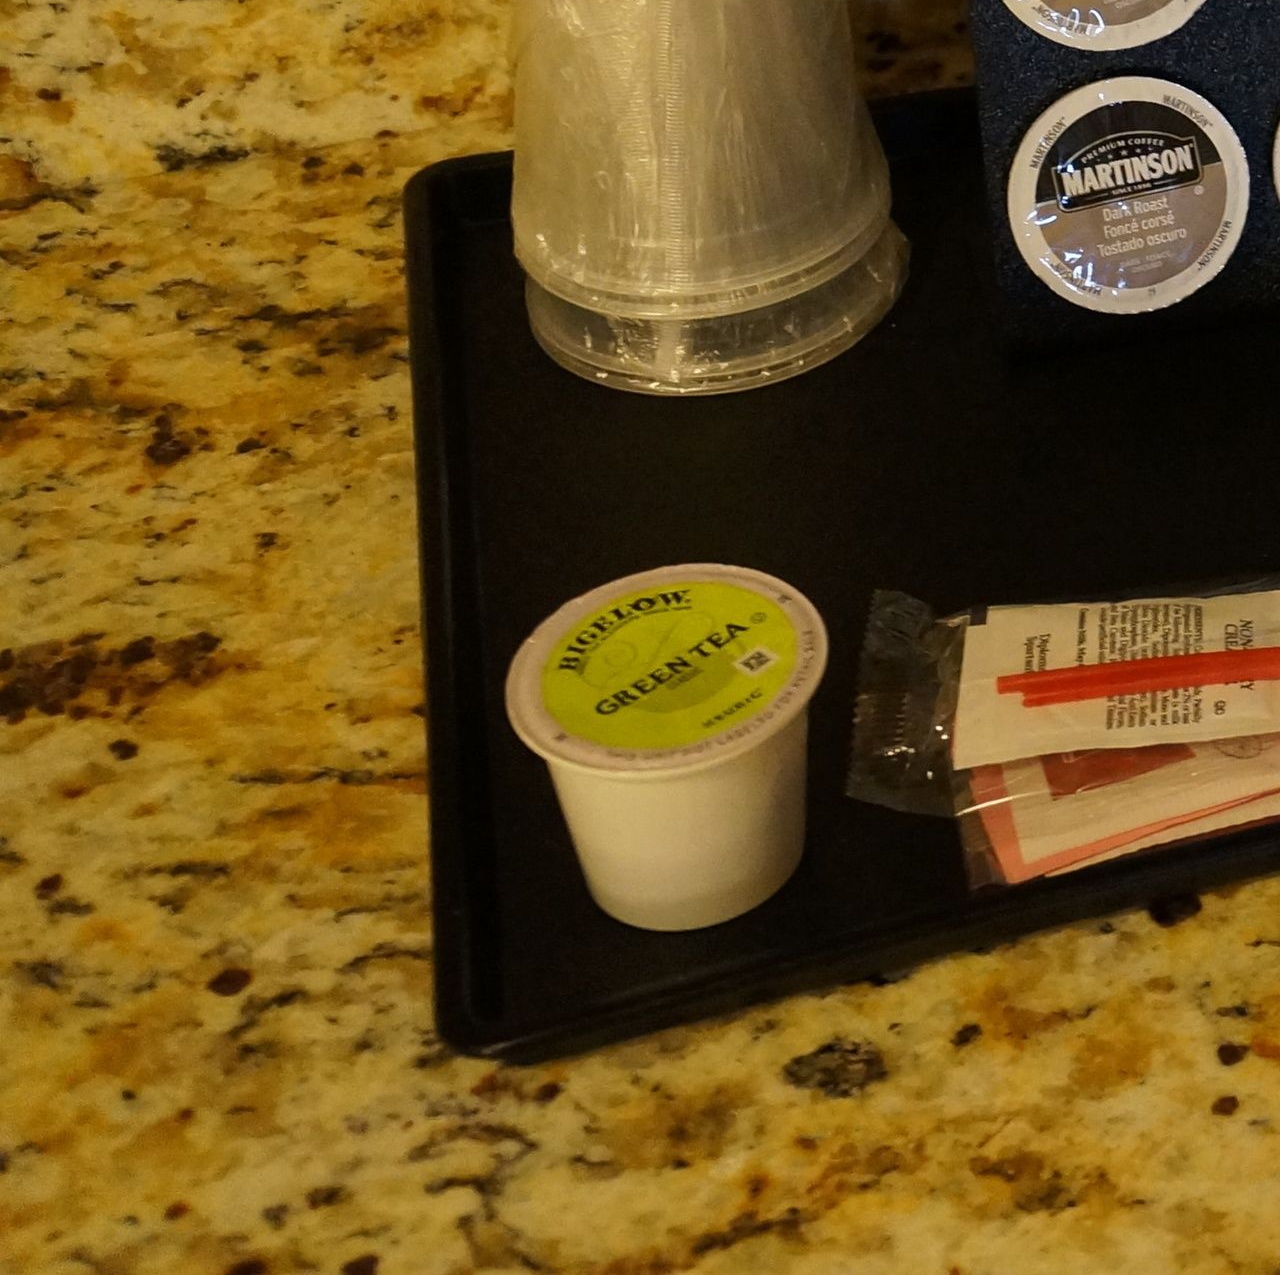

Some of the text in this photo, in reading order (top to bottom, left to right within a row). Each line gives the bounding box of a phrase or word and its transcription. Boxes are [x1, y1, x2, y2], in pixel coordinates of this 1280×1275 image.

[1080, 136, 1165, 164] PREMIUM COFFEE
[1061, 144, 1194, 198] MARTINSON
[1102, 196, 1169, 222] Dark Roast
[1103, 210, 1176, 239] Foncé corsé
[1096, 227, 1188, 259] Tostado oscuro
[558, 588, 692, 672] BIGELOW
[593, 655, 693, 716] GREEN
[687, 622, 749, 660] TEA
